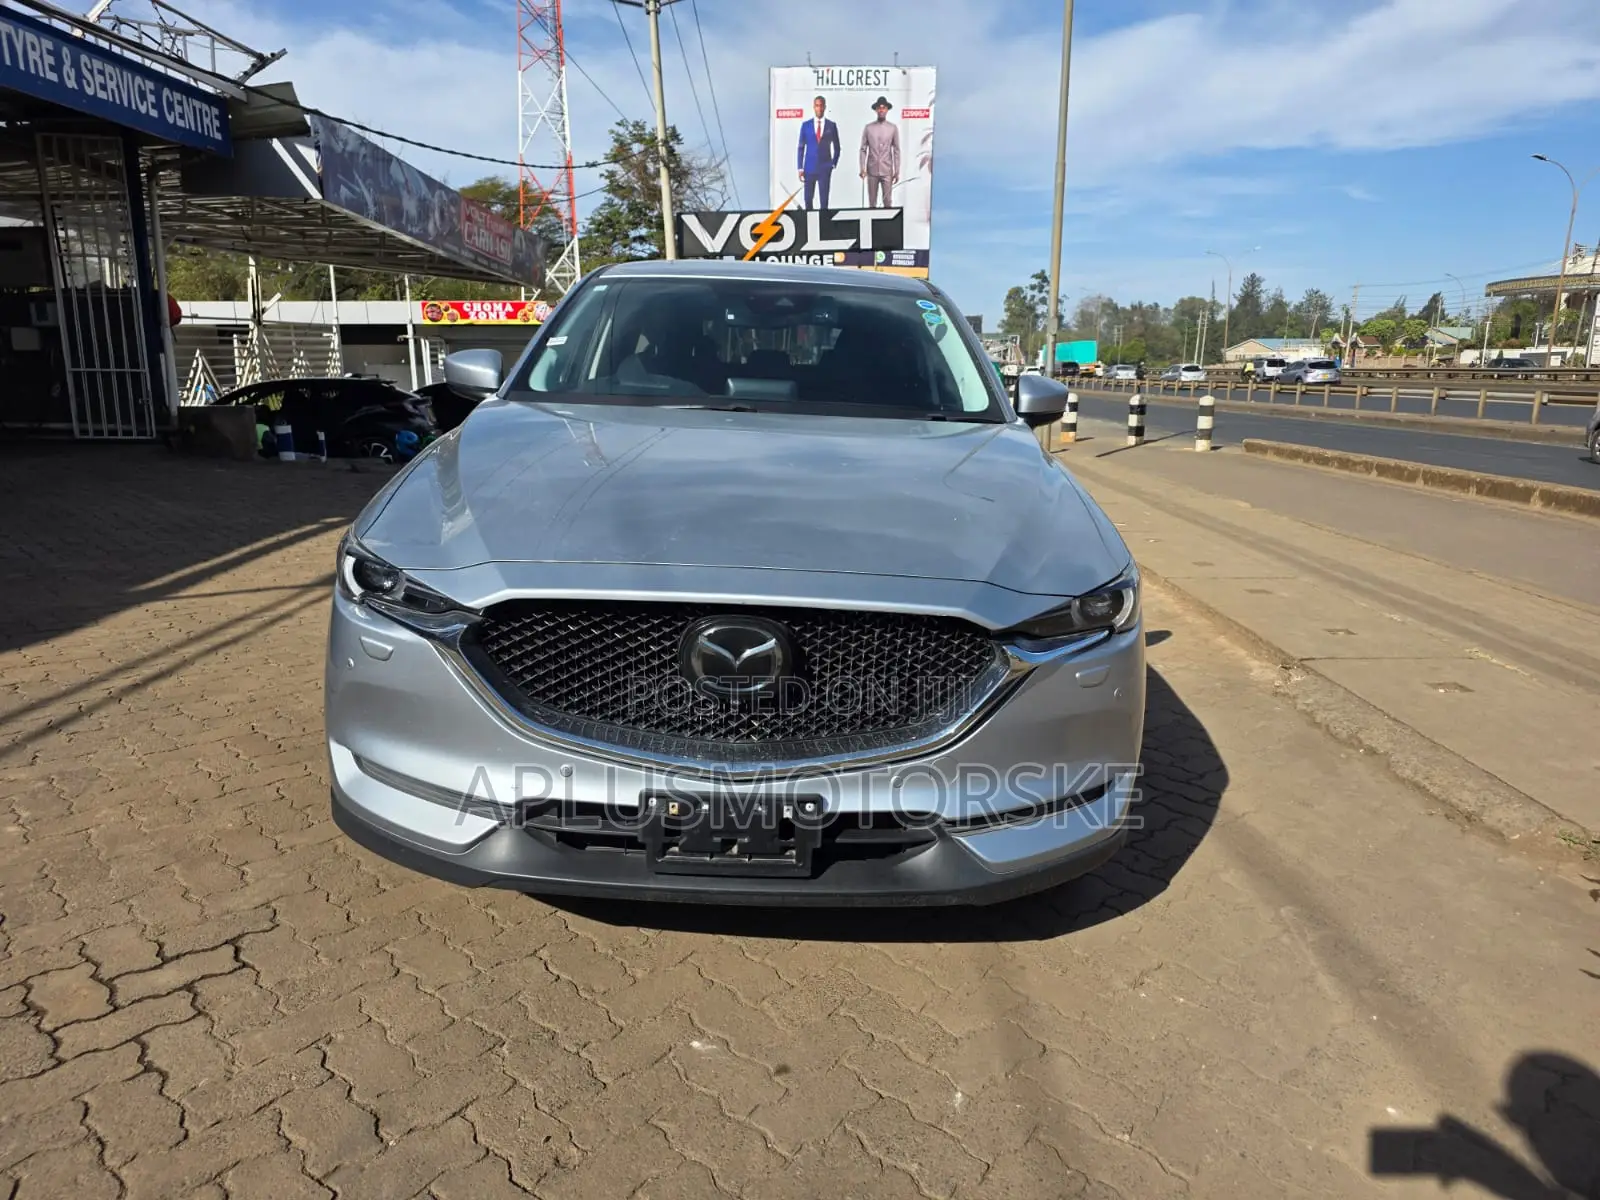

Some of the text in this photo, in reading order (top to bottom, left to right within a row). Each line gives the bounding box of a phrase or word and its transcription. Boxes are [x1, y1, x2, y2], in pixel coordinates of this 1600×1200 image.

[0, 23, 223, 141] TYRE & SERVICE CENTRE
[681, 209, 902, 253] VOLT
[462, 302, 514, 312] CHOMA
[468, 311, 507, 320] ZONE
